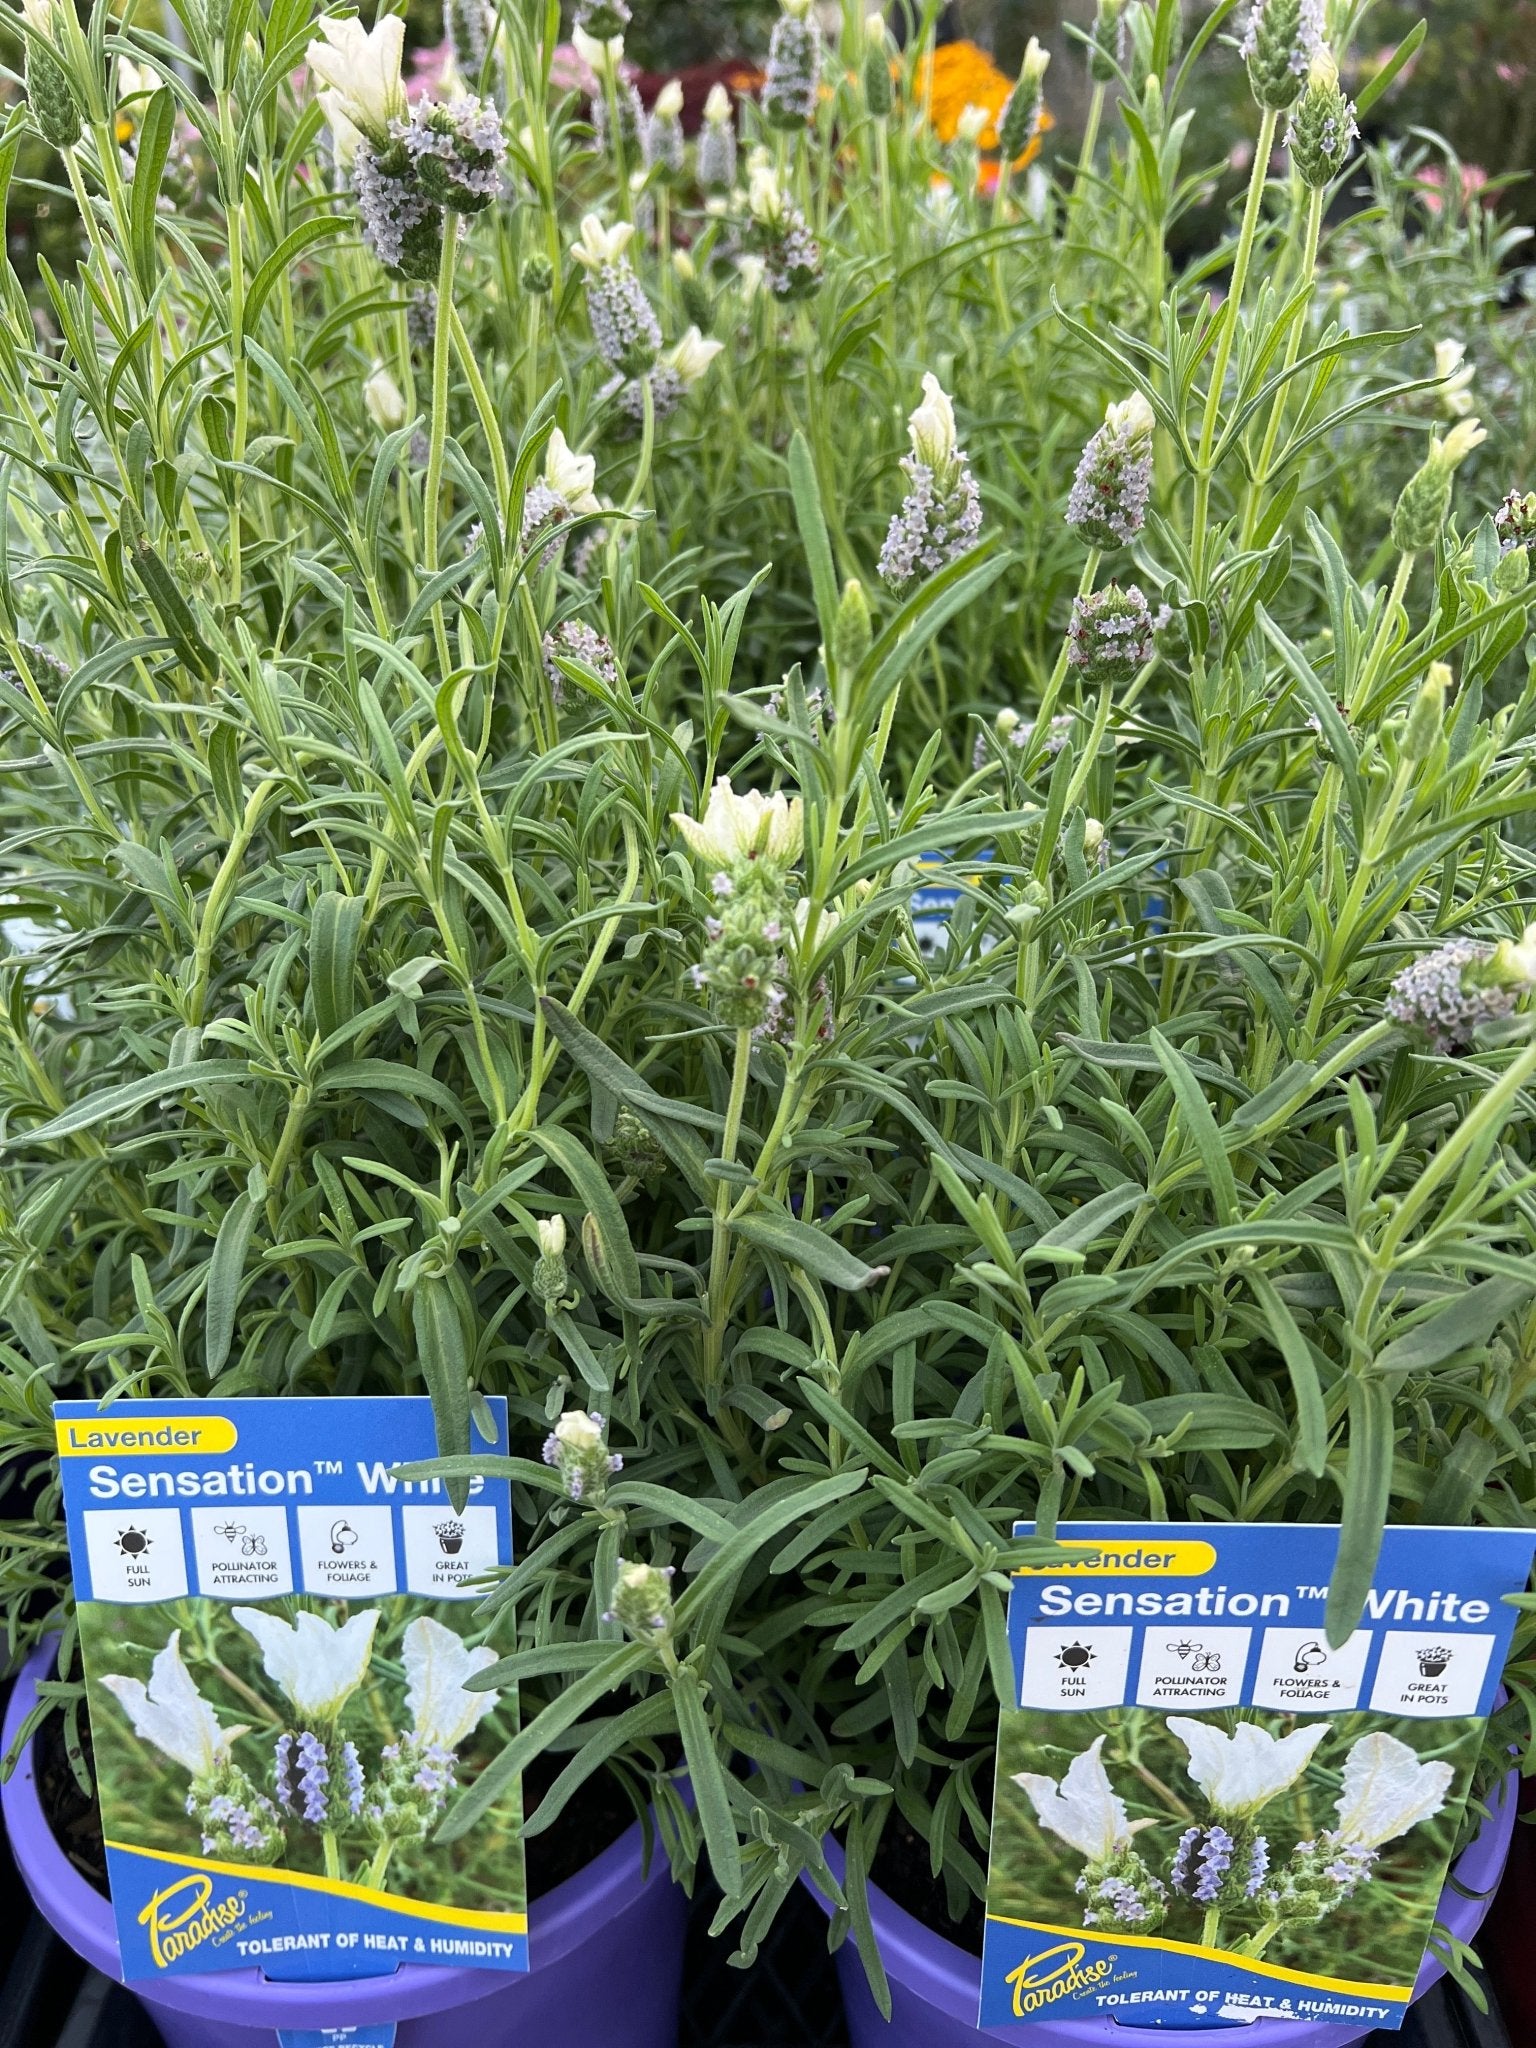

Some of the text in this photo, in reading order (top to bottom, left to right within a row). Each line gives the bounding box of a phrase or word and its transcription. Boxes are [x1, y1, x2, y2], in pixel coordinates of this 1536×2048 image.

[69, 1426, 201, 1448] Lavender
[126, 1565, 150, 1575] FULL
[212, 1562, 278, 1571] POLLINATOR
[318, 1561, 378, 1570] FLOWERS &
[435, 1561, 469, 1570] GREAT
[213, 1574, 279, 1584] ATTRACTING
[327, 1573, 371, 1582] FOLIAGE
[432, 1574, 444, 1582] IN
[128, 1578, 151, 1587] SUN
[1061, 1677, 1087, 1685] FULL
[1154, 1676, 1227, 1685] POLLINATOR
[1273, 1678, 1341, 1688] FLOWERS &
[1060, 1688, 1085, 1697] SUN
[1152, 1688, 1226, 1697] ATTRACTING
[1408, 1683, 1448, 1693] GREAT
[1280, 1690, 1330, 1699] FOLIAGE
[1400, 1694, 1448, 1704] IN POTS
[236, 1933, 513, 1958] TOLERANT OF HEAT & HUMIDITY
[1095, 1990, 1390, 2019] TOLERANT OF HEAT & HUMIDITY
